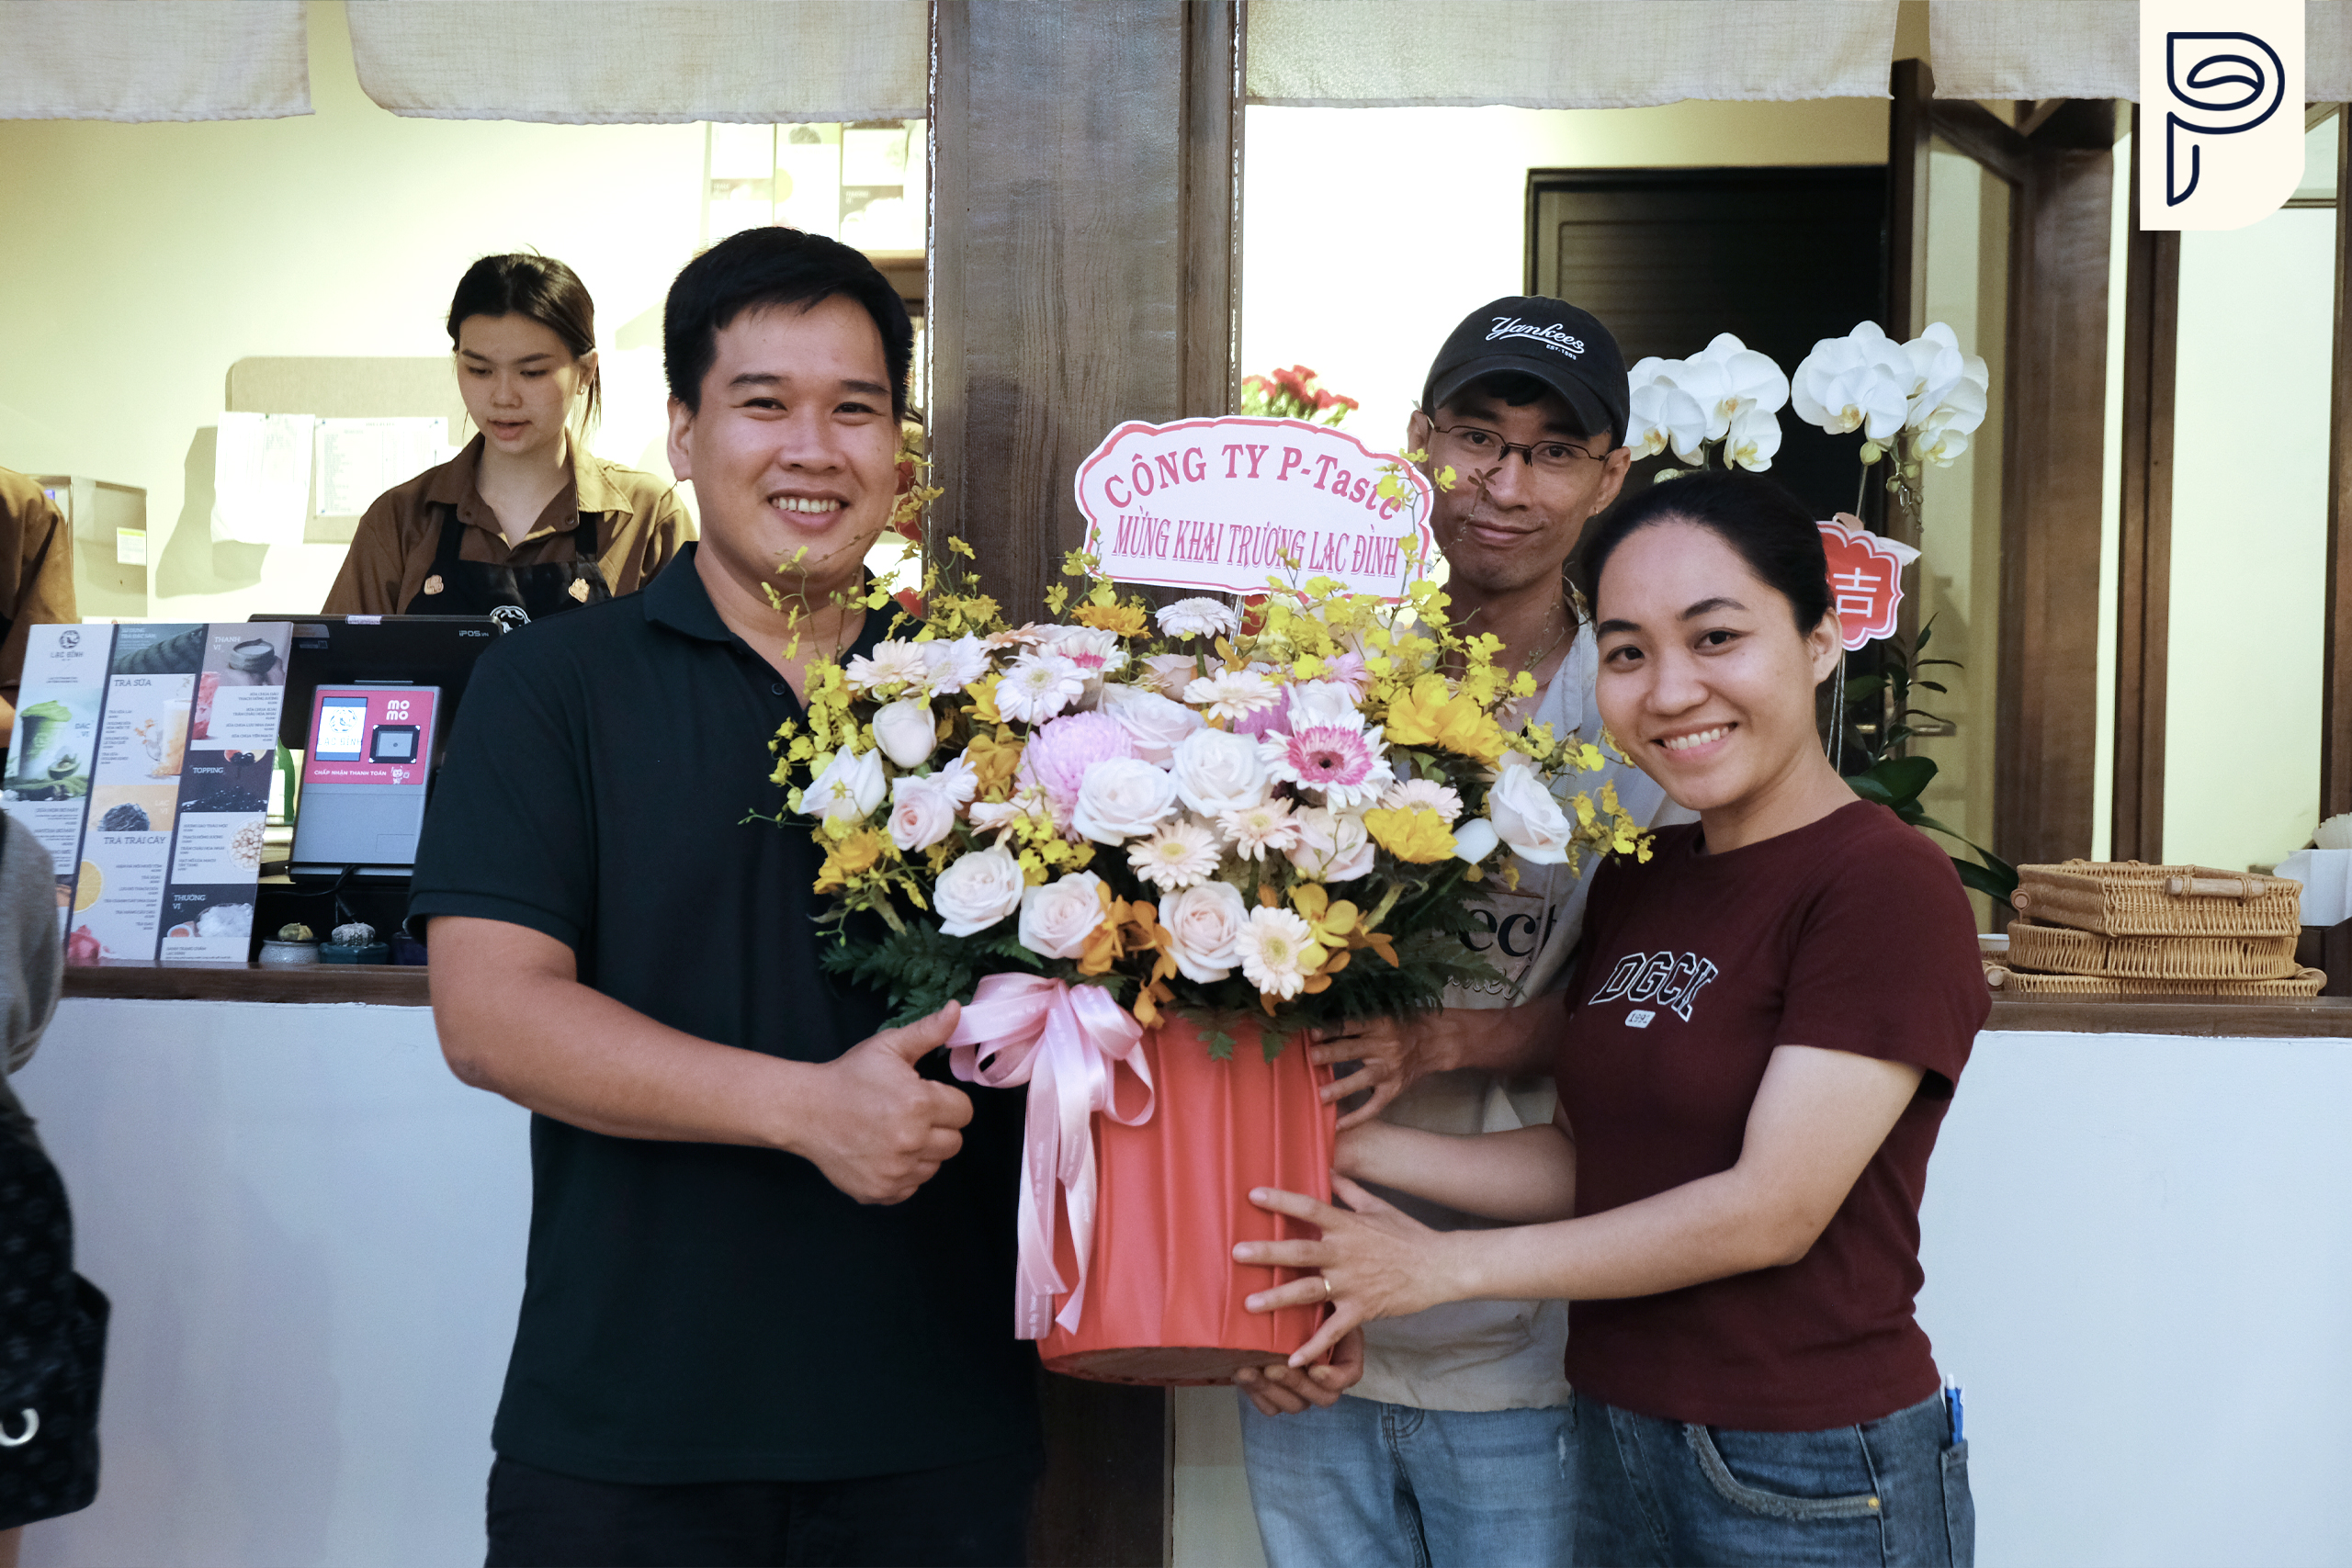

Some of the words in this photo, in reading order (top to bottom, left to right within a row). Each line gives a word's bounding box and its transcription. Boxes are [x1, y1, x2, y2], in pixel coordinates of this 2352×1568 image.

[1485, 316, 1585, 350] Yankees
[1104, 446, 1206, 508] CÔNG
[1221, 444, 1269, 479] TY
[1172, 520, 1224, 564] KHAI
[1350, 524, 1400, 578] ĐÌNH
[1833, 567, 1882, 618] 吉
[1588, 951, 1719, 1022] DGCK
